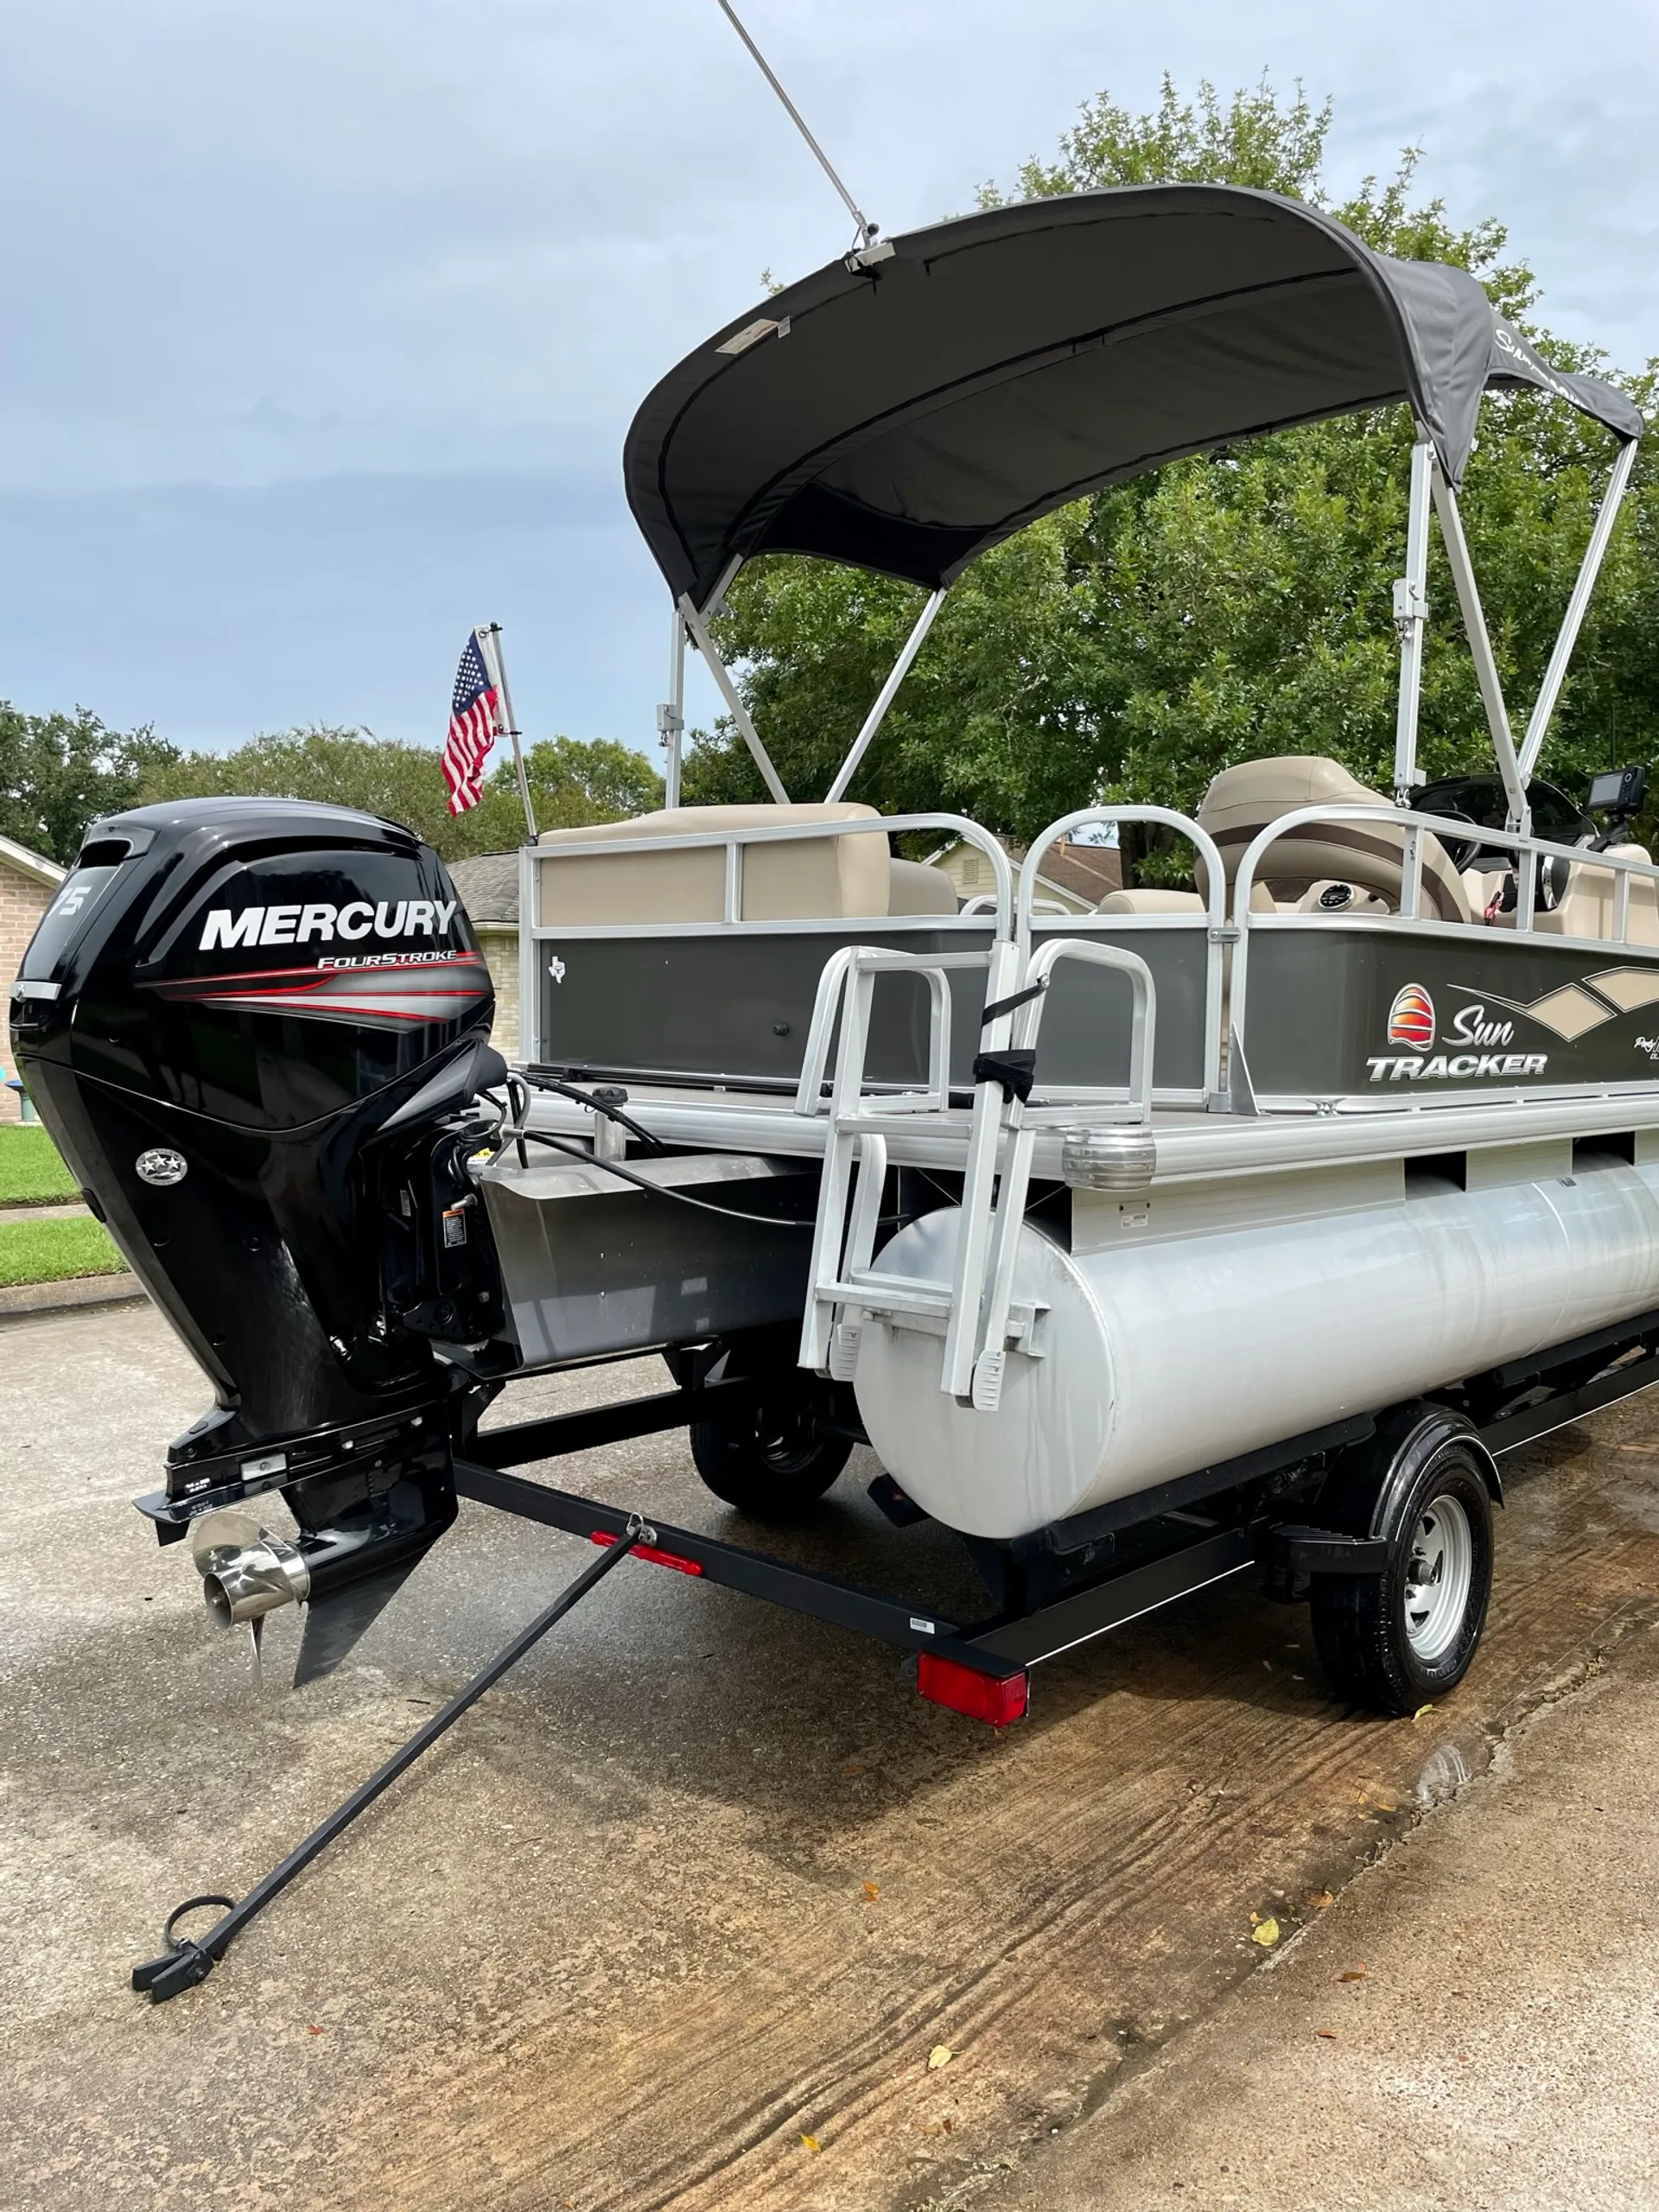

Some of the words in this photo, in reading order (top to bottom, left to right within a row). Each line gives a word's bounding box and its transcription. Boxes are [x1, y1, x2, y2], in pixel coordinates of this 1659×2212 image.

[199, 900, 457, 950] MERCURY
[1441, 1004, 1515, 1046] Sun
[1366, 1053, 1548, 1082] TRACKER
